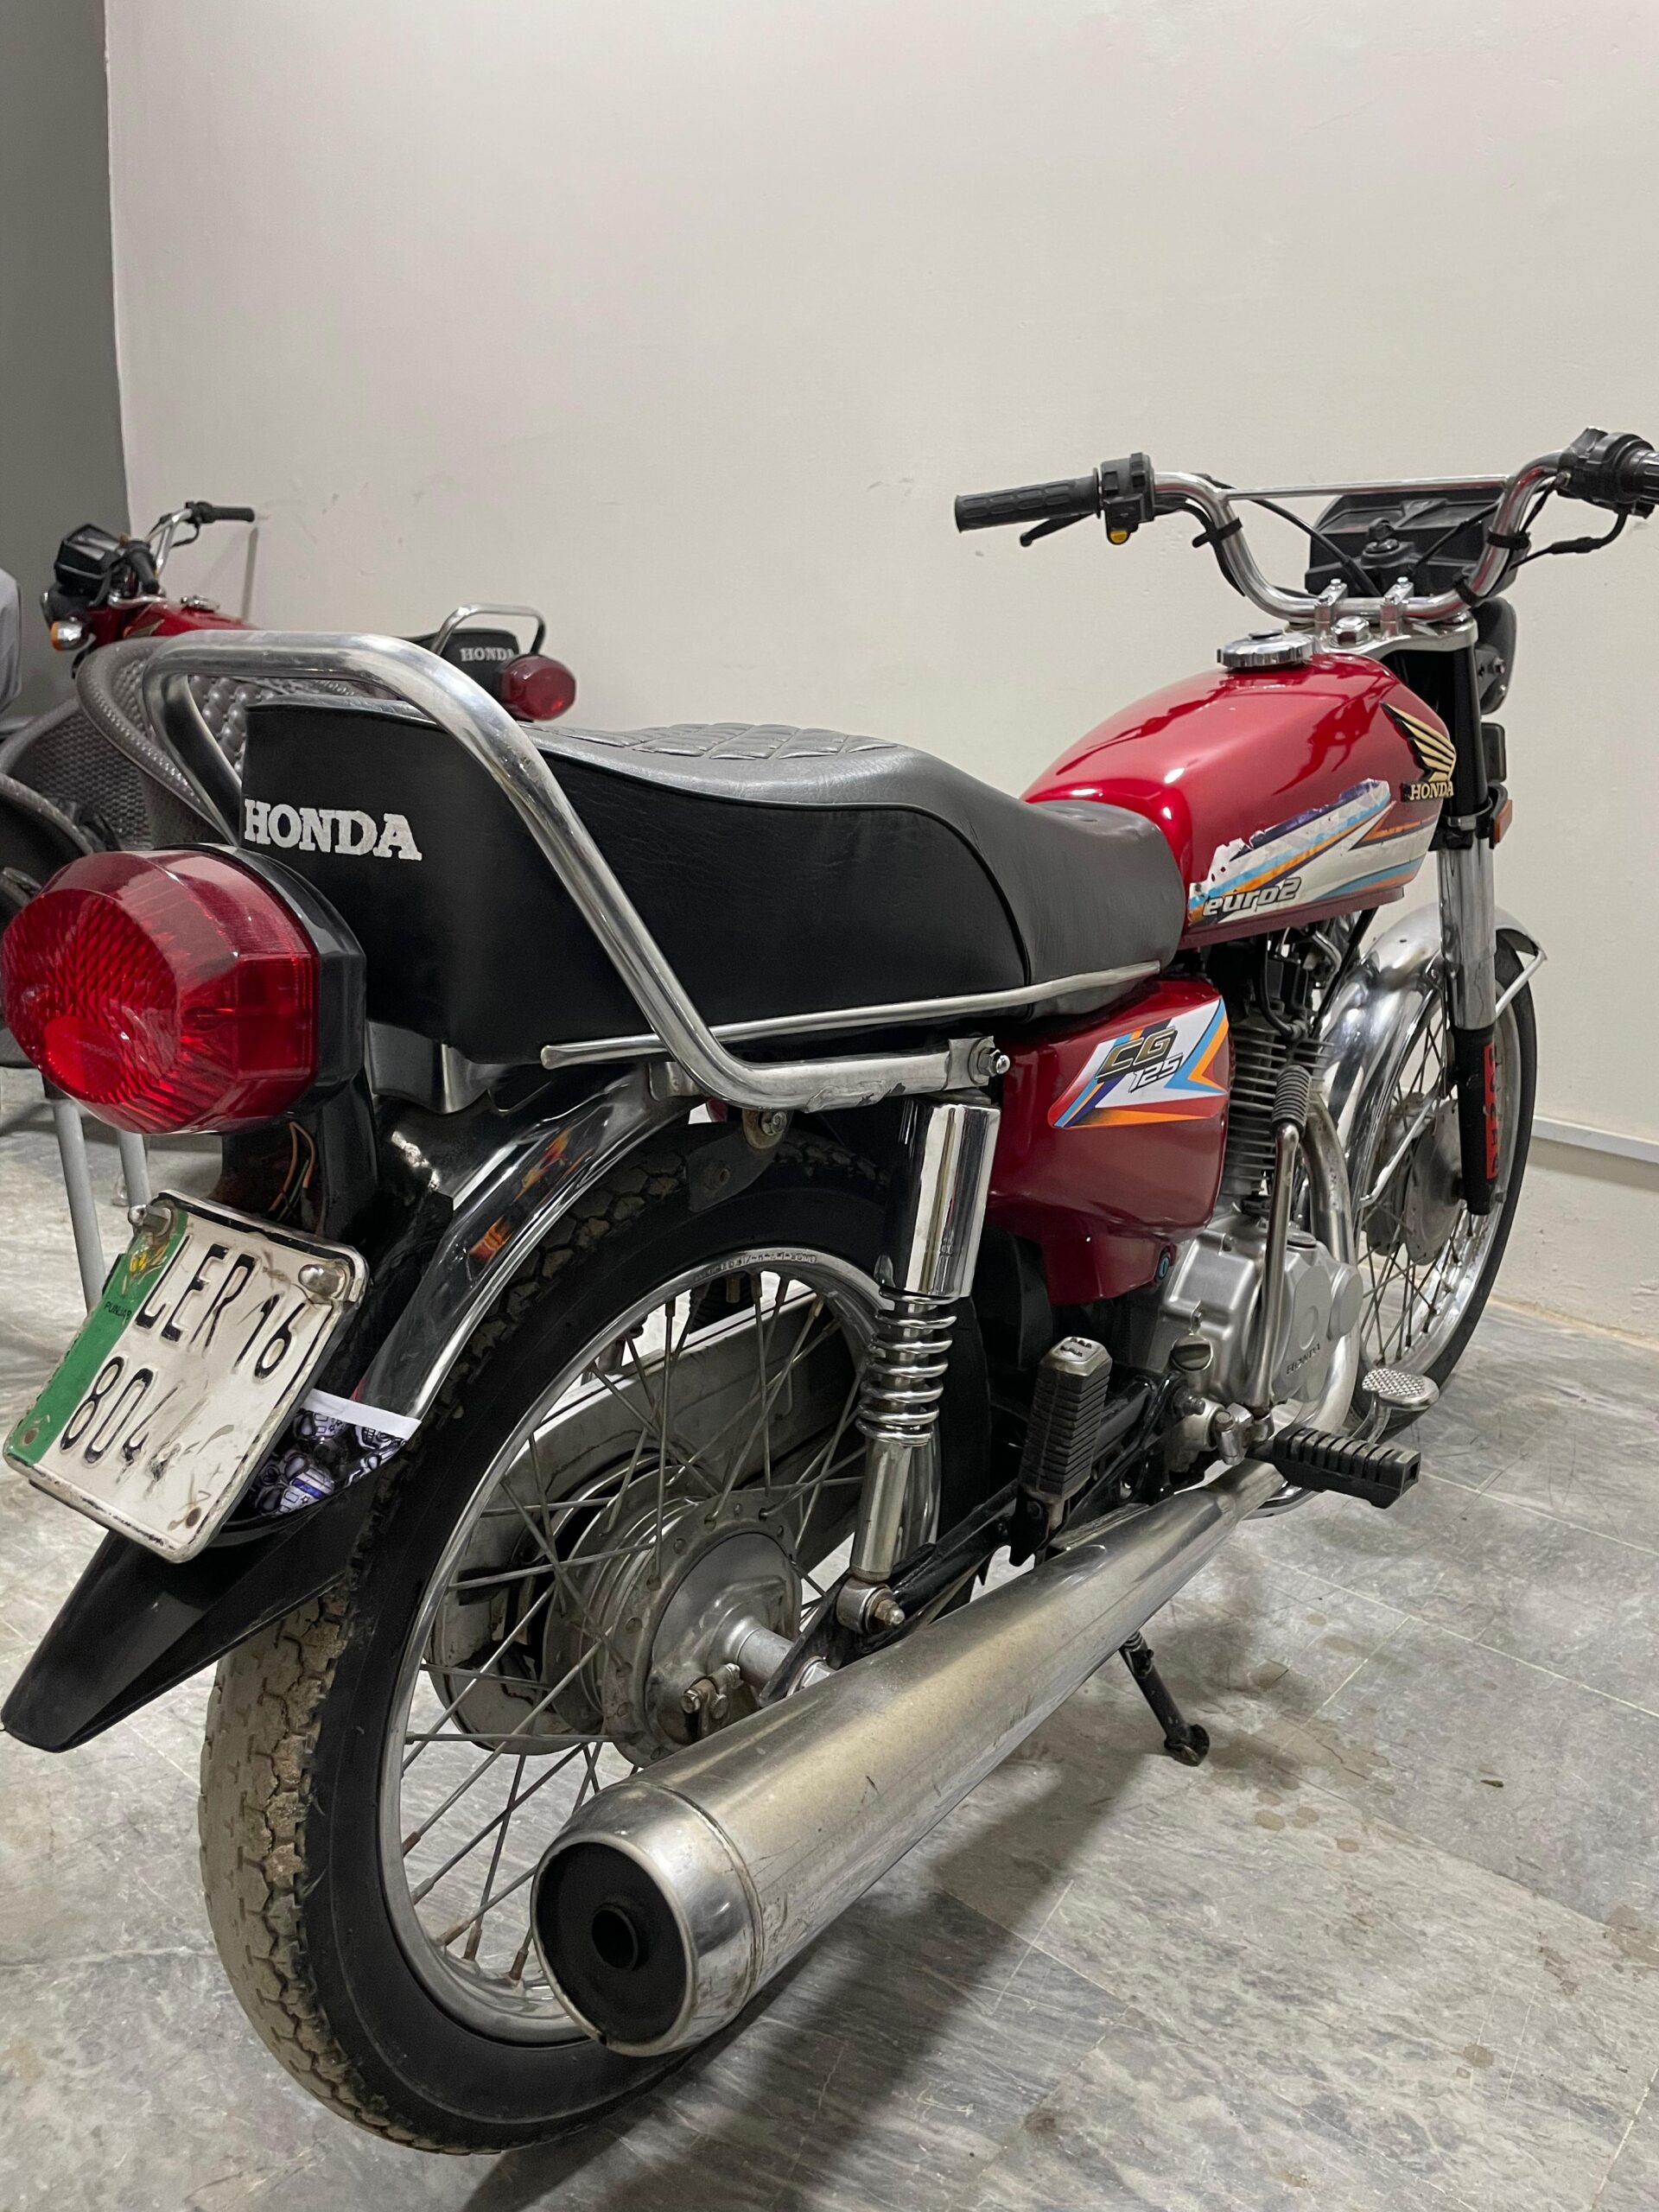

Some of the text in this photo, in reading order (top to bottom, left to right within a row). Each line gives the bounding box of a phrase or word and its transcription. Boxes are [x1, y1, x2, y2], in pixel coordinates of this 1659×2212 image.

[1408, 781, 1454, 802] HONDA
[244, 798, 423, 861] HONDA
[1202, 876, 1301, 917] euro2
[1095, 1027, 1179, 1083] CG
[1128, 1052, 1184, 1093] 125
[136, 1234, 307, 1380] LER 16
